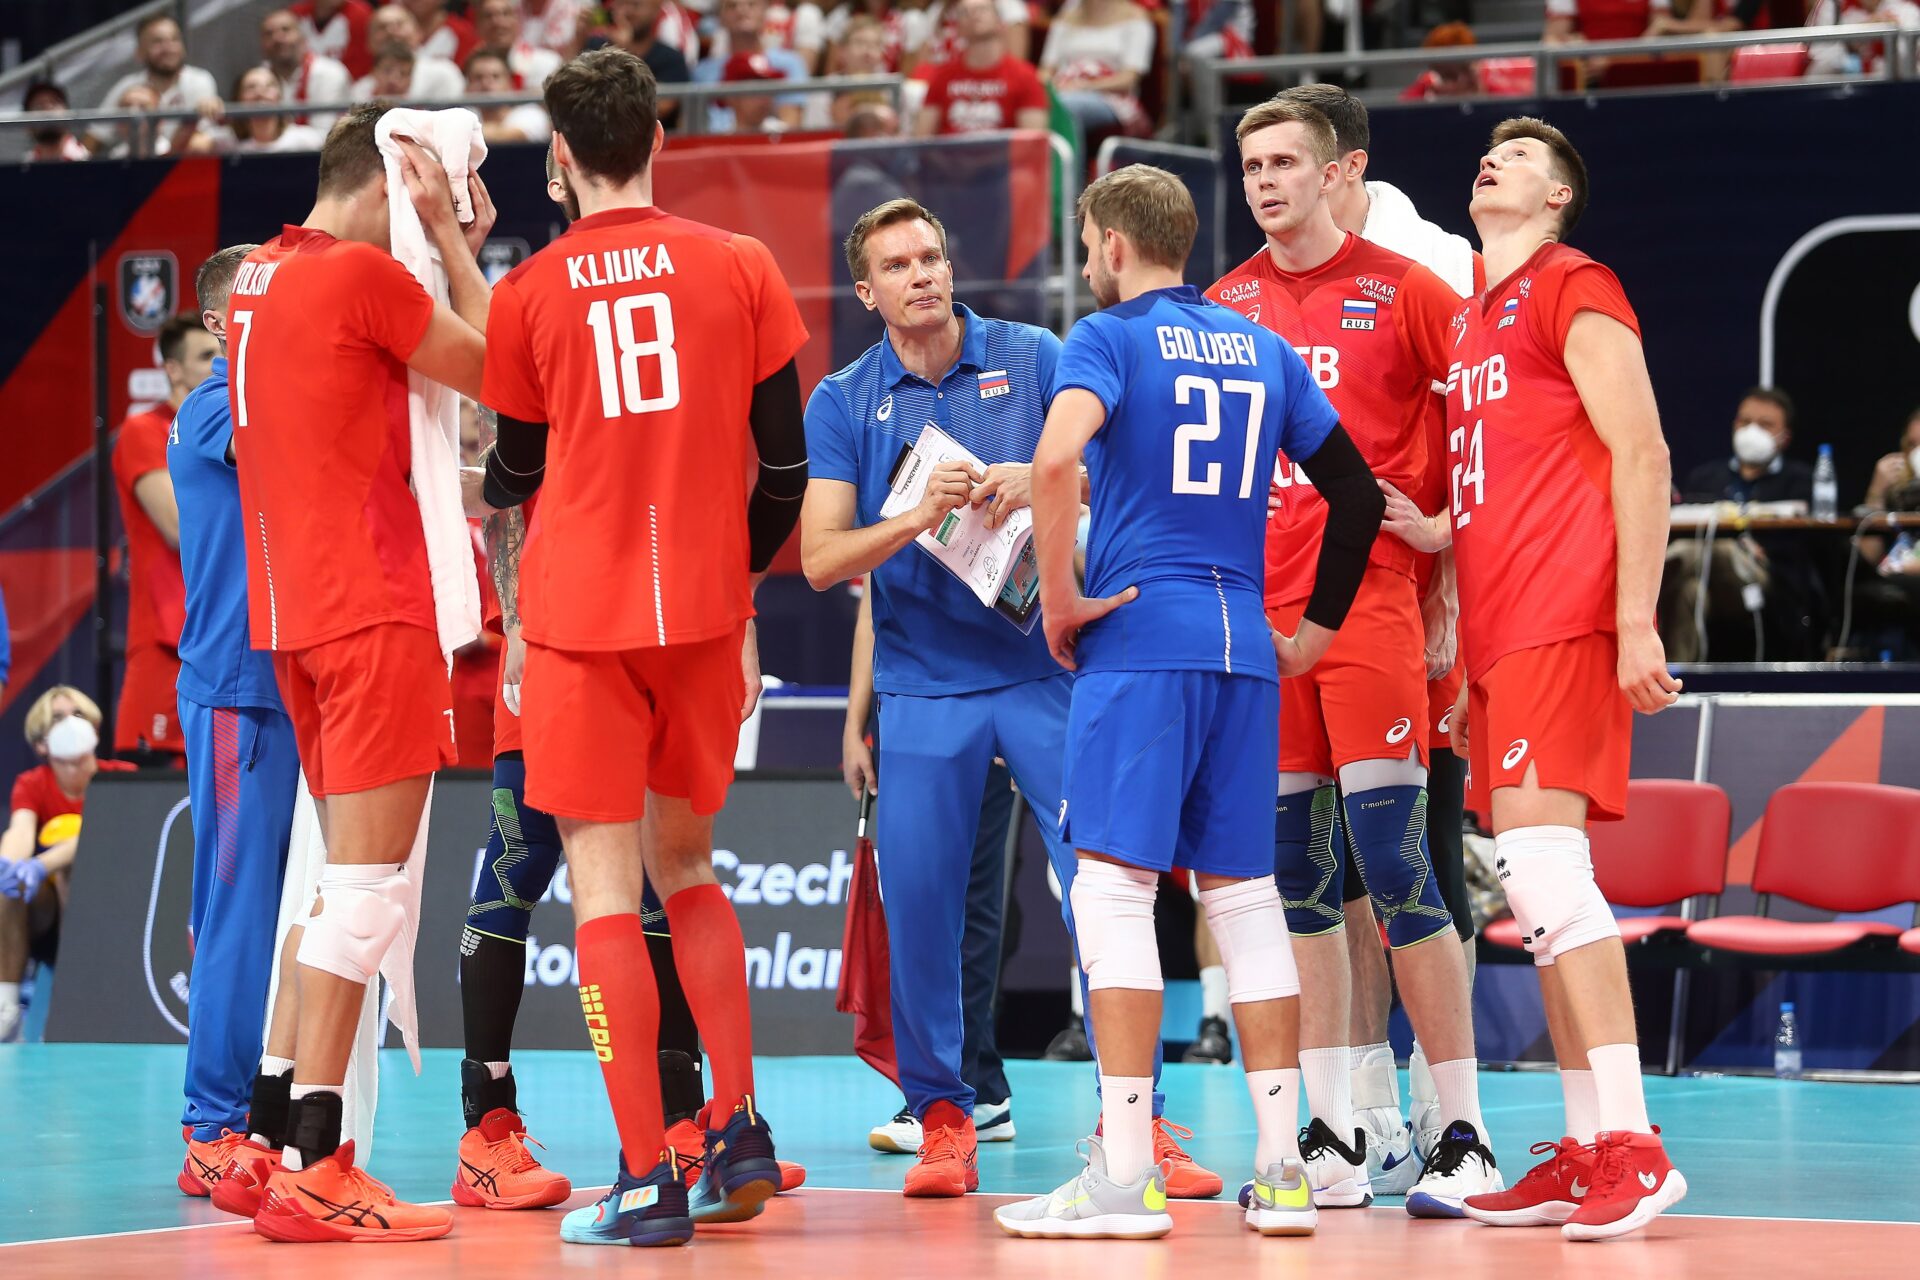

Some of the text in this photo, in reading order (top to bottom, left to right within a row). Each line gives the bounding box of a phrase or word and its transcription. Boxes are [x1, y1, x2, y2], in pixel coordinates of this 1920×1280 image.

[566, 243, 675, 289] KLIUKA
[1220, 280, 1260, 301] QATAR
[1231, 289, 1261, 304] AIRWAYS
[1355, 276, 1396, 298] QATAR
[1360, 288, 1394, 305] AIRWAYS
[1346, 320, 1370, 329] RUS
[586, 292, 681, 419] 18
[1156, 325, 1257, 367] GOLUBEV
[232, 310, 254, 427] 7
[984, 386, 1006, 397] RUS
[1172, 374, 1266, 499] 27
[1450, 418, 1486, 530] 24
